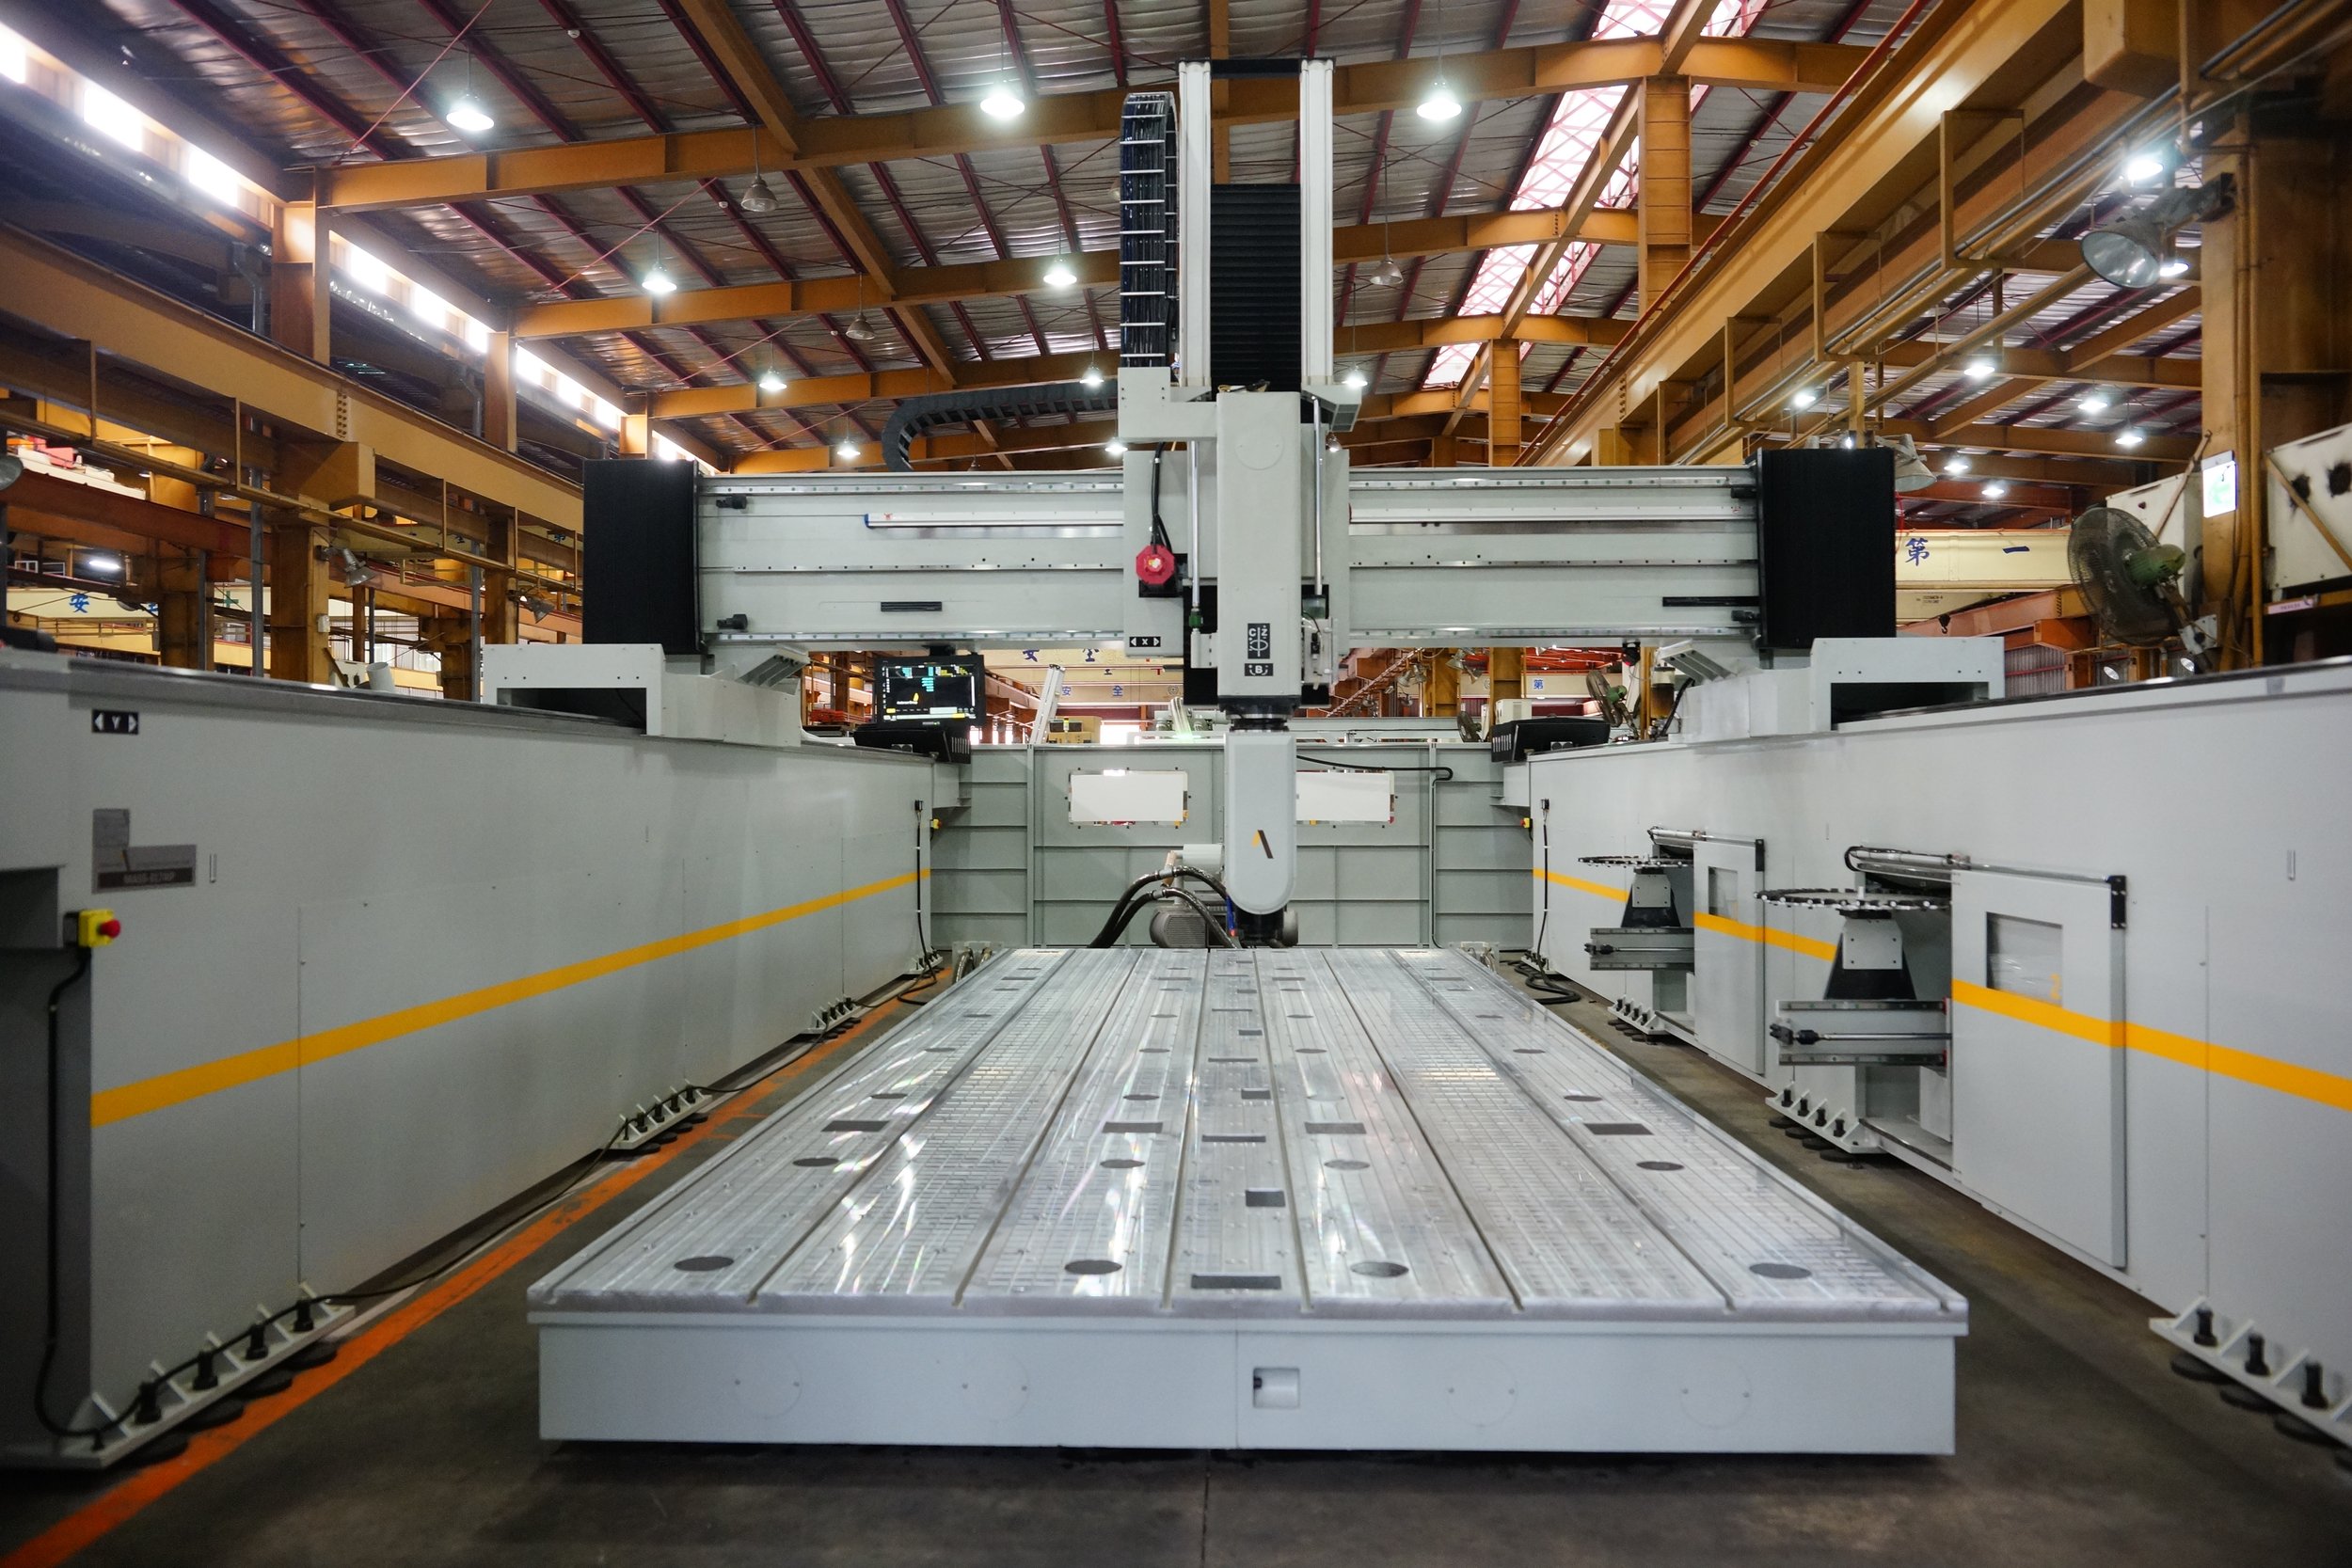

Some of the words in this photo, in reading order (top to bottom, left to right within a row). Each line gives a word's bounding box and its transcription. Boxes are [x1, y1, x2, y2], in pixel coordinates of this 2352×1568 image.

[1905, 537, 1930, 566] 第
[2002, 546, 2030, 554] 一
[69, 594, 89, 613] 安
[1248, 627, 1257, 637] C
[1255, 665, 1263, 673] B
[1112, 685, 1123, 697] 全
[111, 715, 121, 730] Y
